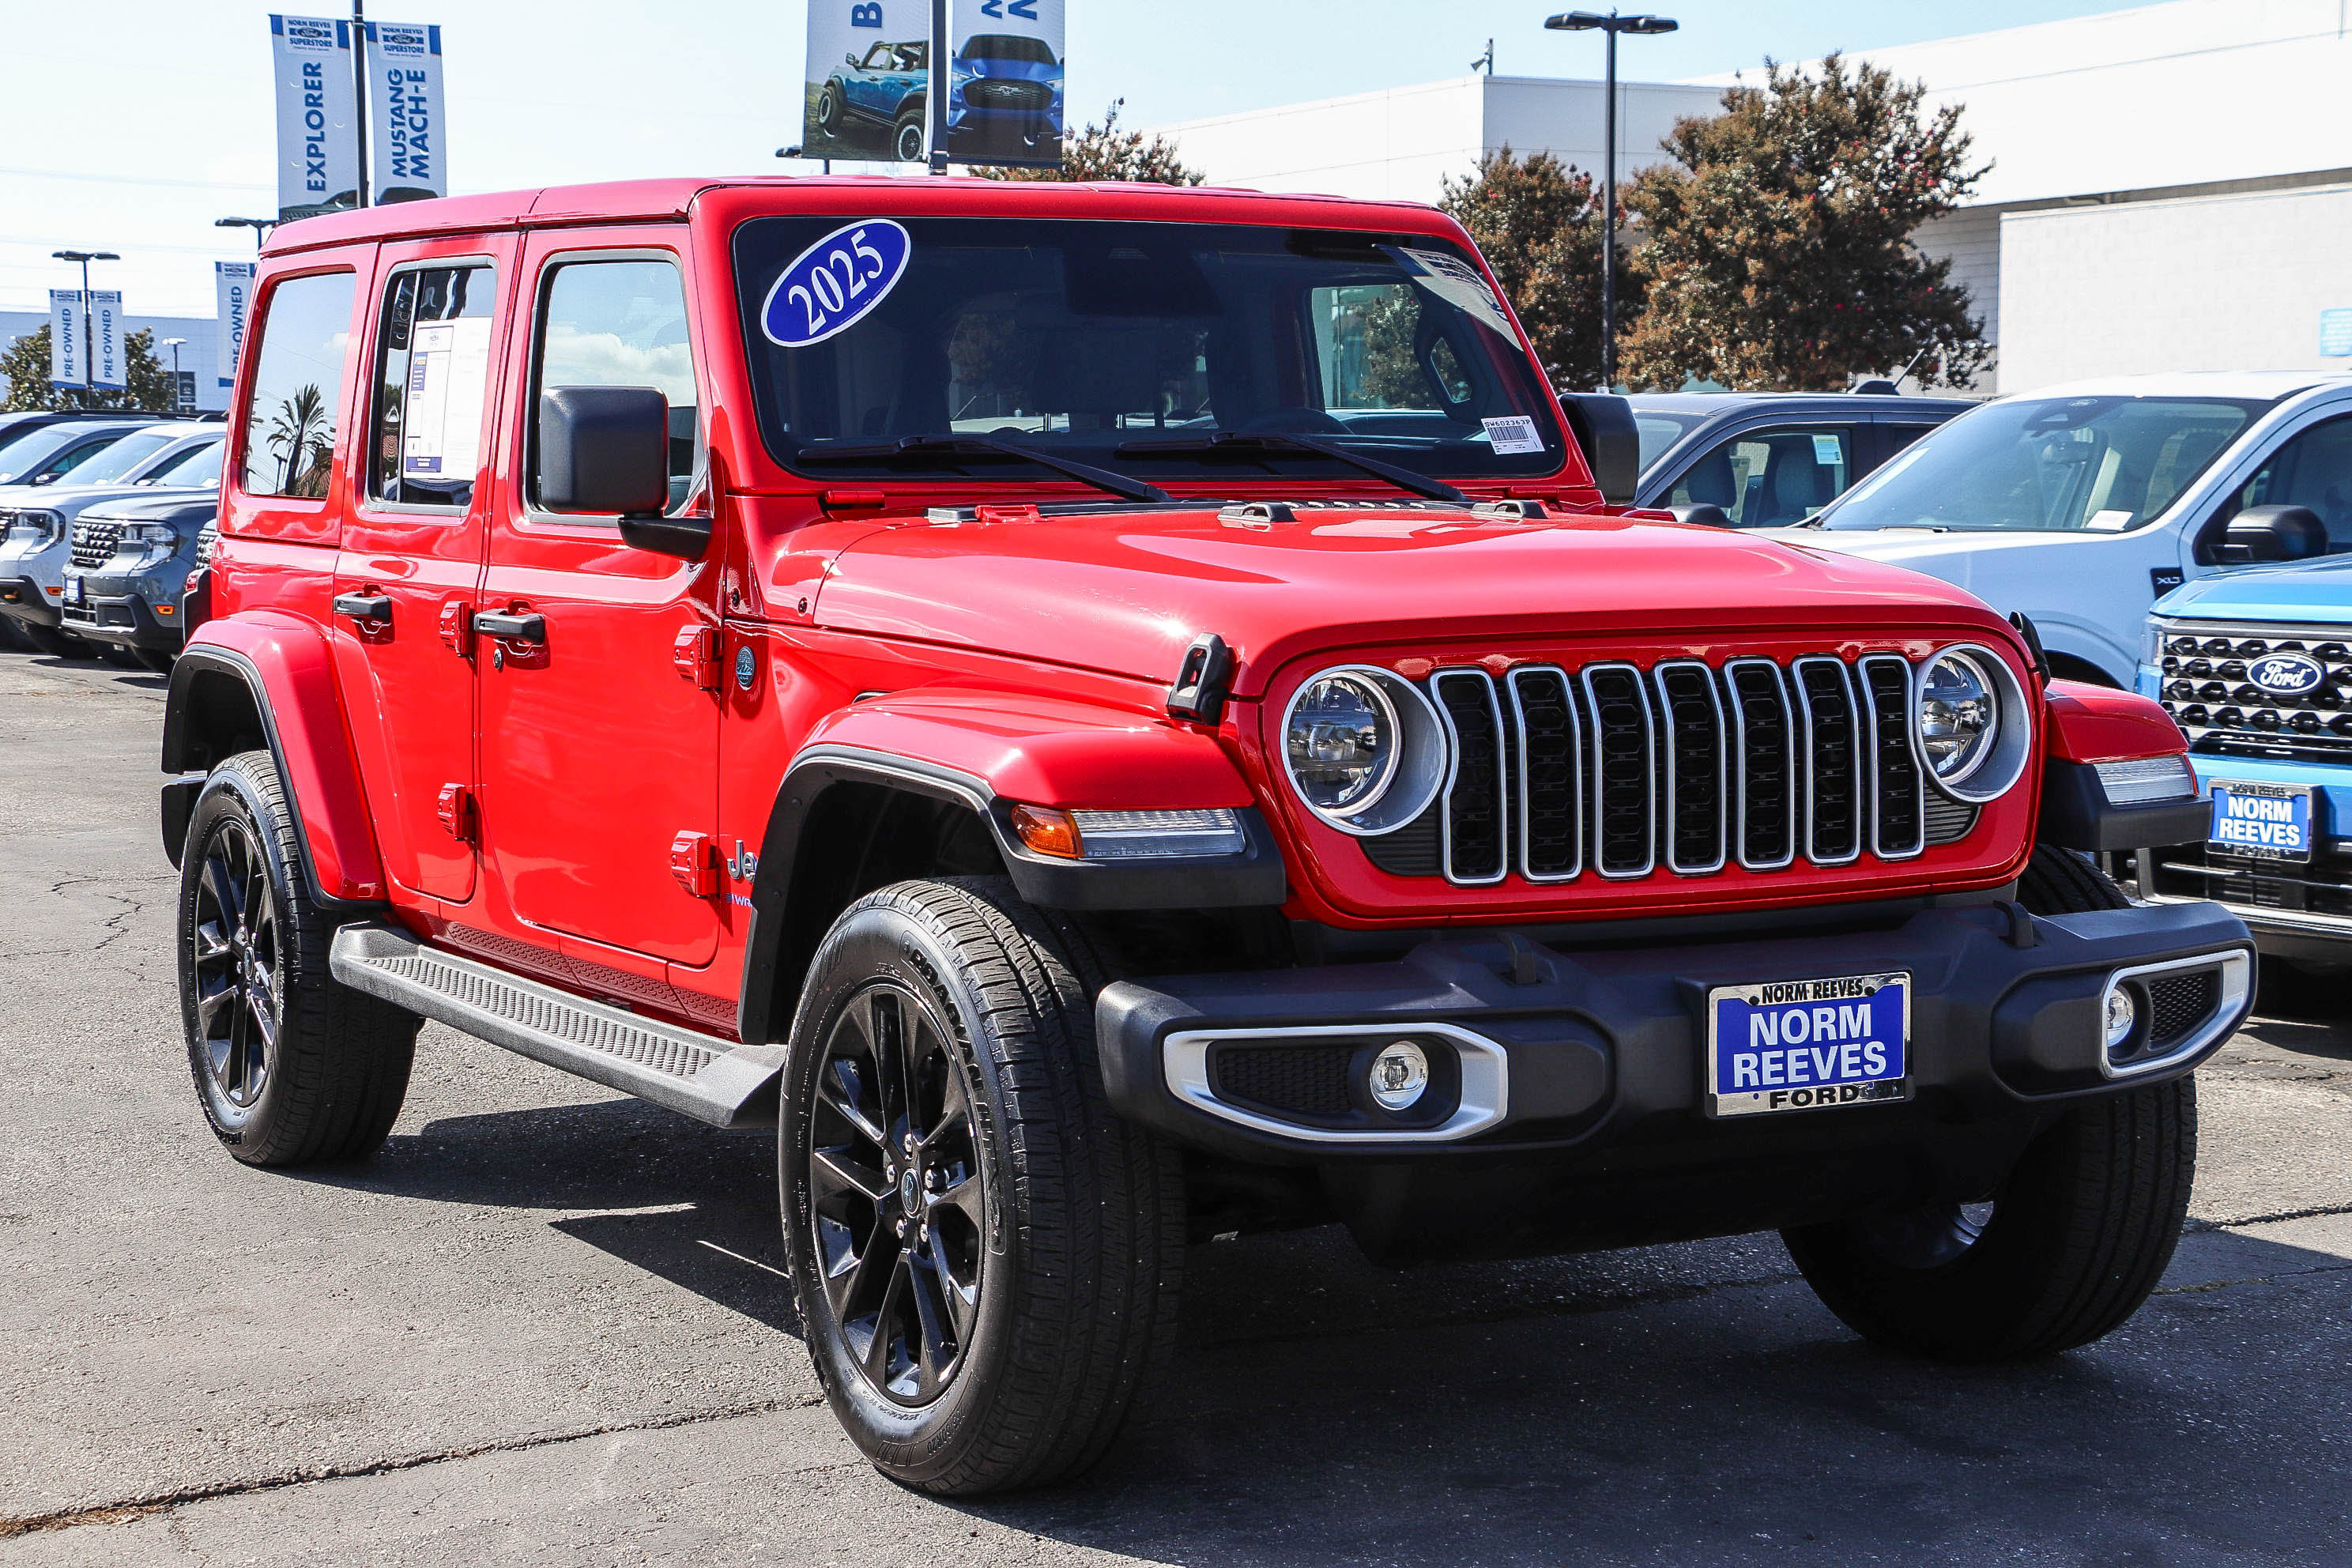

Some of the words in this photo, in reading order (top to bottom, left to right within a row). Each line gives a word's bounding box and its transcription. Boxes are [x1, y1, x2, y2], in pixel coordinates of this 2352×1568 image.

[289, 37, 333, 47] SUPERSTORE
[303, 62, 326, 192] EXPLORER
[387, 68, 407, 178] MUSTANG
[406, 70, 430, 179] MACH-E
[788, 228, 884, 336] 2025
[62, 308, 74, 378] PRE-OWNED
[102, 309, 113, 379] PRE-OWNED
[1484, 419, 1531, 428] SW602363P
[2259, 661, 2313, 688] Ford
[2228, 796, 2293, 823] NORM
[2218, 818, 2301, 846] REEVES
[1762, 983, 1809, 1004] NORM
[1812, 978, 1864, 1000] REEVES
[1750, 1004, 1871, 1047] NORM
[1733, 1041, 1887, 1088] REEVES
[1770, 1084, 1860, 1110] FORD
